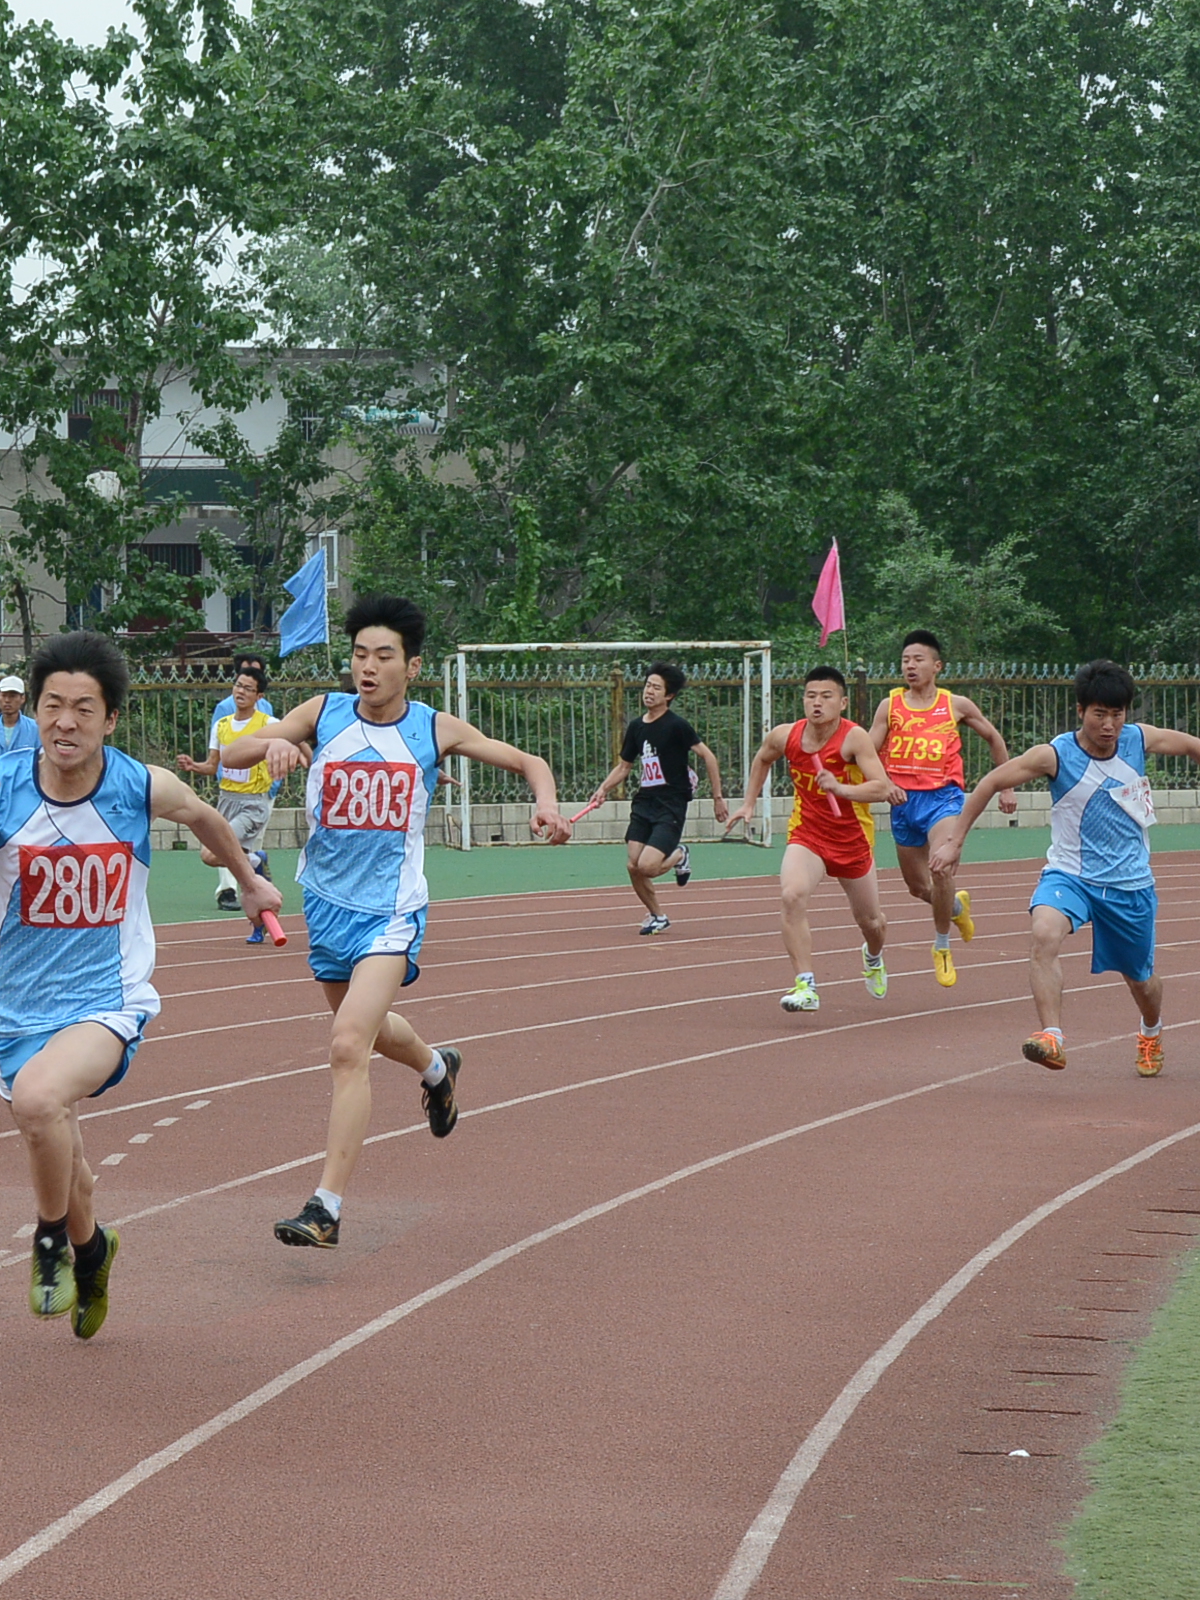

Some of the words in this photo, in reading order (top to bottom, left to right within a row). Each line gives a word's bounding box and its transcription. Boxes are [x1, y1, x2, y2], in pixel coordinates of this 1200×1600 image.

[890, 735, 943, 761] 2733
[642, 761, 663, 781] 02
[327, 769, 410, 827] 2803
[28, 852, 127, 924] 2802
